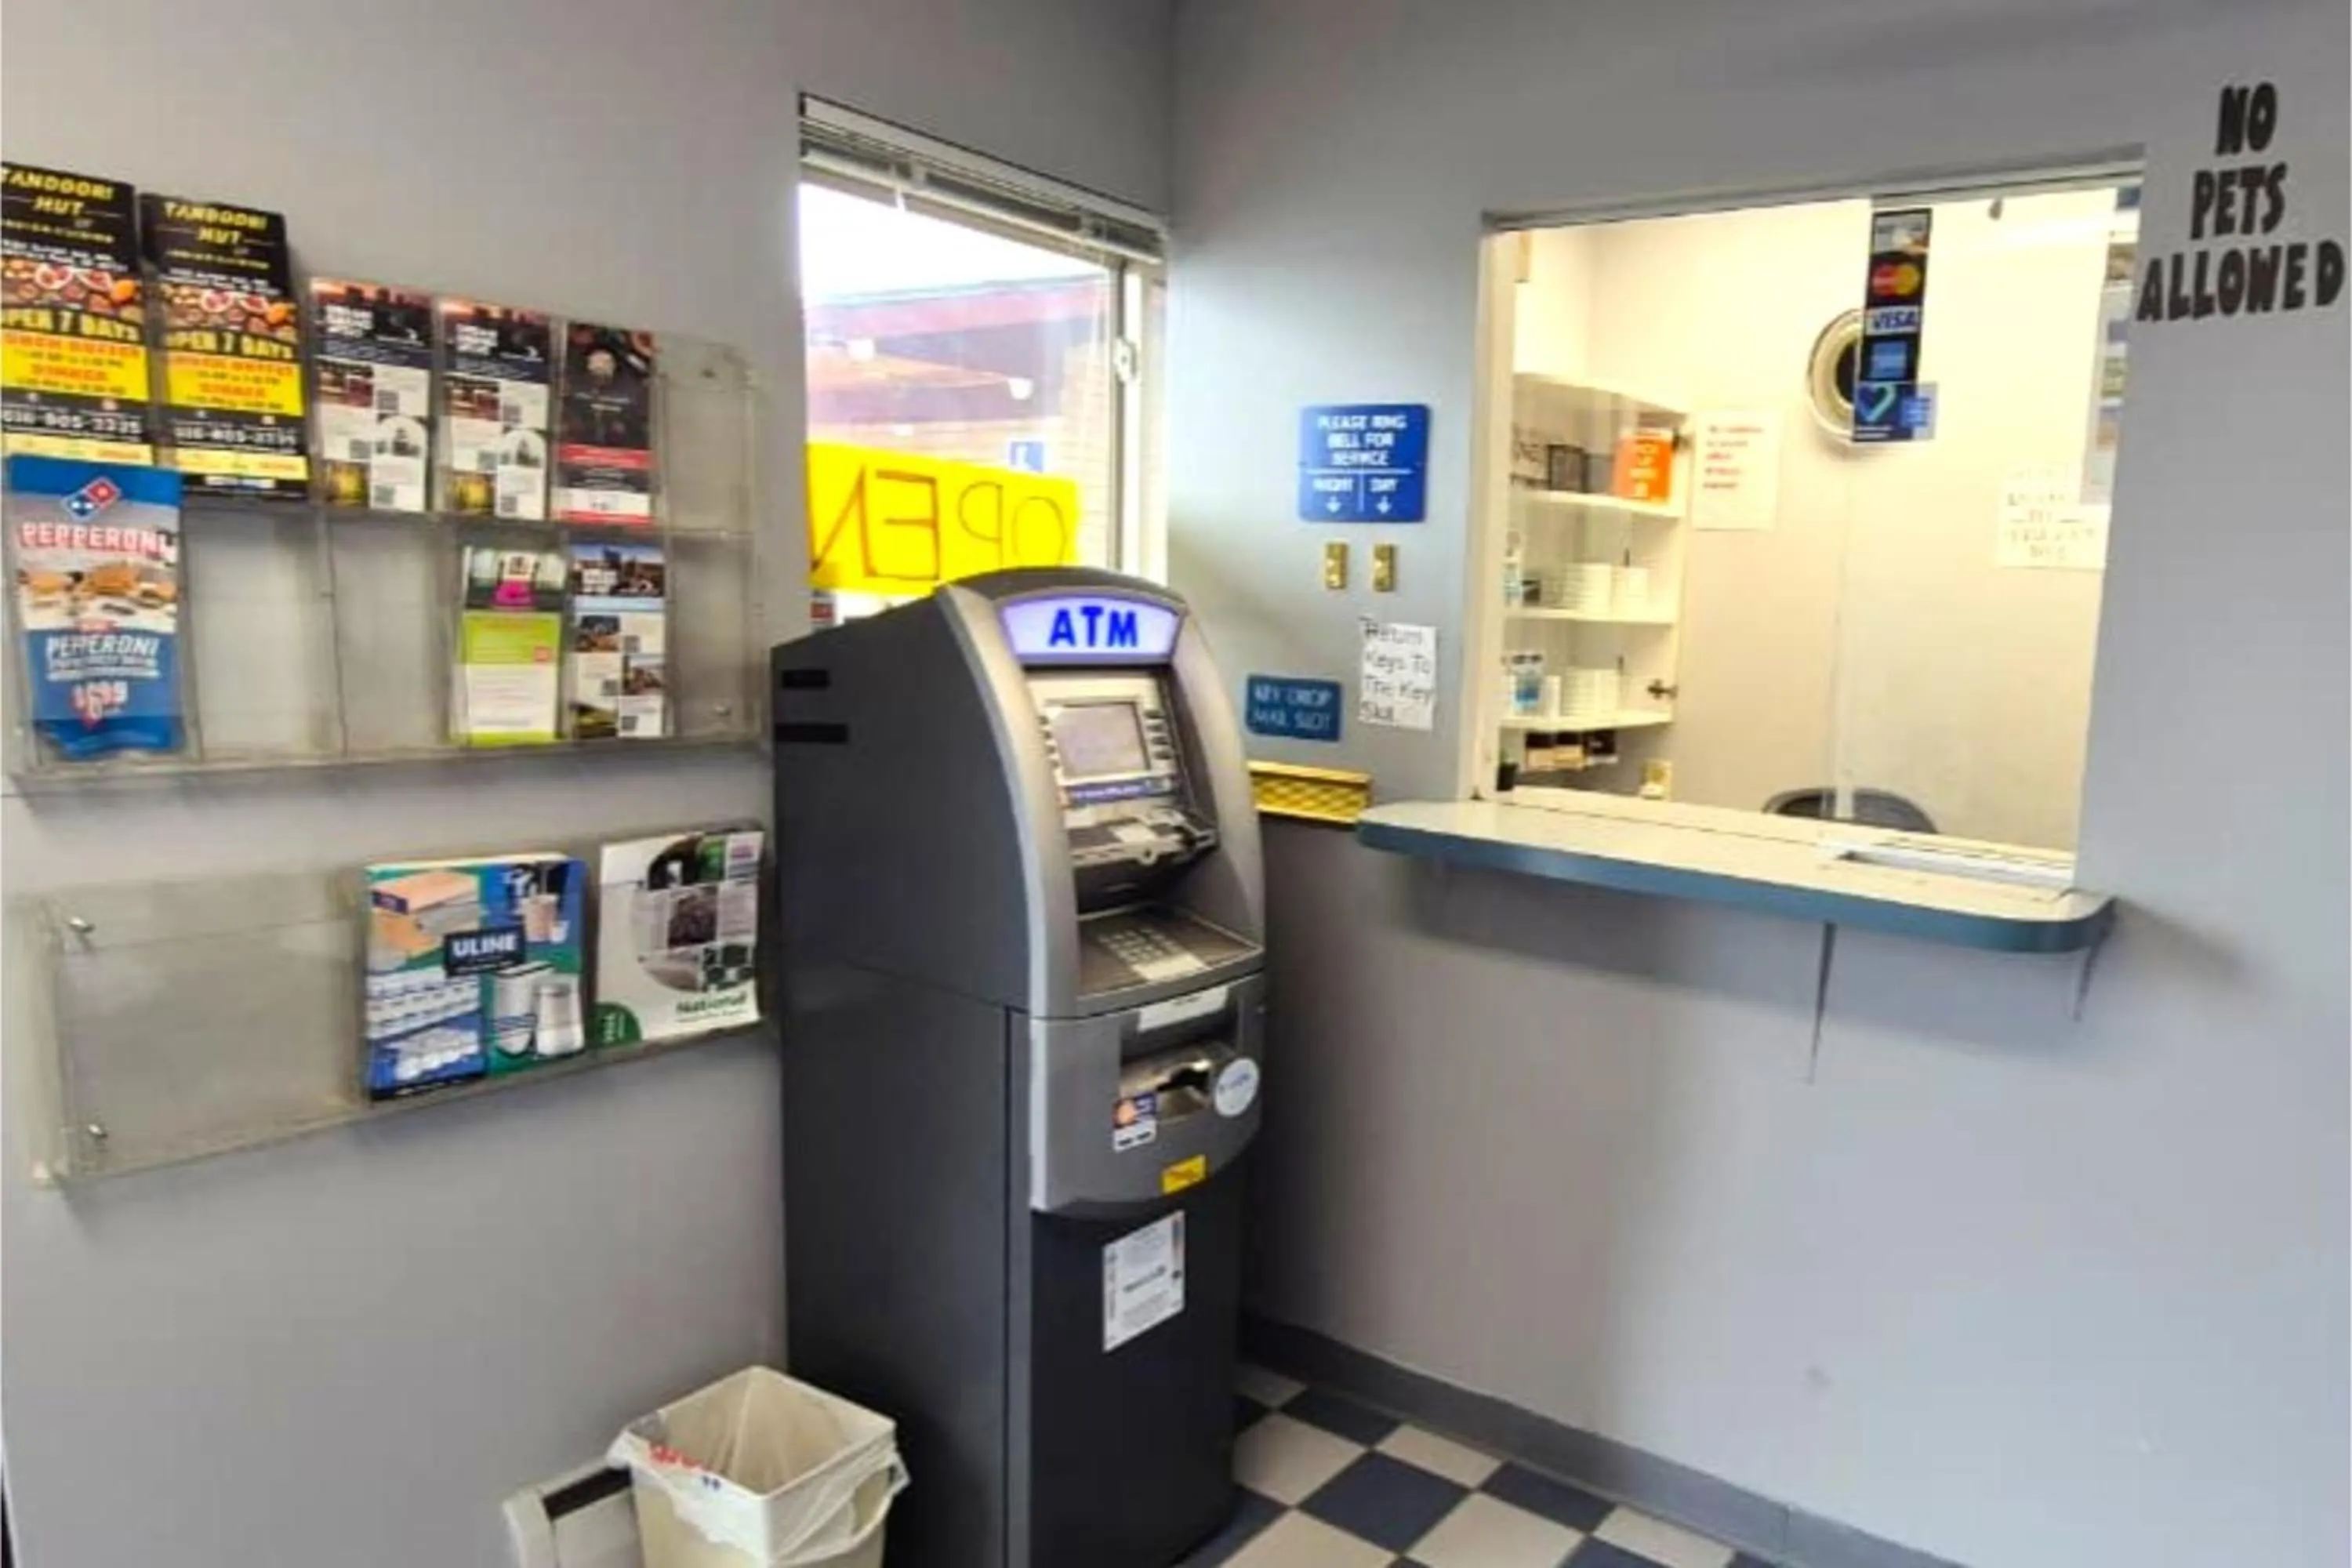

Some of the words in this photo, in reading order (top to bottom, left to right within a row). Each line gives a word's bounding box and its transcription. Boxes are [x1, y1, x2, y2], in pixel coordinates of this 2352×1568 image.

[2216, 82, 2277, 155] NO
[2190, 162, 2288, 240] PETS
[2136, 239, 2346, 321] ALLOWED
[1875, 312, 1917, 329] VISA
[1317, 414, 1367, 430] PLEASE
[1371, 414, 1406, 430] RING
[1327, 432, 1359, 448] BELL
[1365, 432, 1393, 448] FOR
[1332, 450, 1388, 466] SERVICE
[1312, 477, 1353, 492] NIGHT
[1370, 477, 1397, 492] DAY
[20, 521, 169, 560] PEPPERONI
[1048, 604, 1138, 648] ATM
[1254, 684, 1280, 702] KEY
[1287, 687, 1332, 706] DROP
[1253, 706, 1287, 727] MAIL
[1294, 710, 1330, 731] SLOT
[452, 932, 517, 957] ULINE
